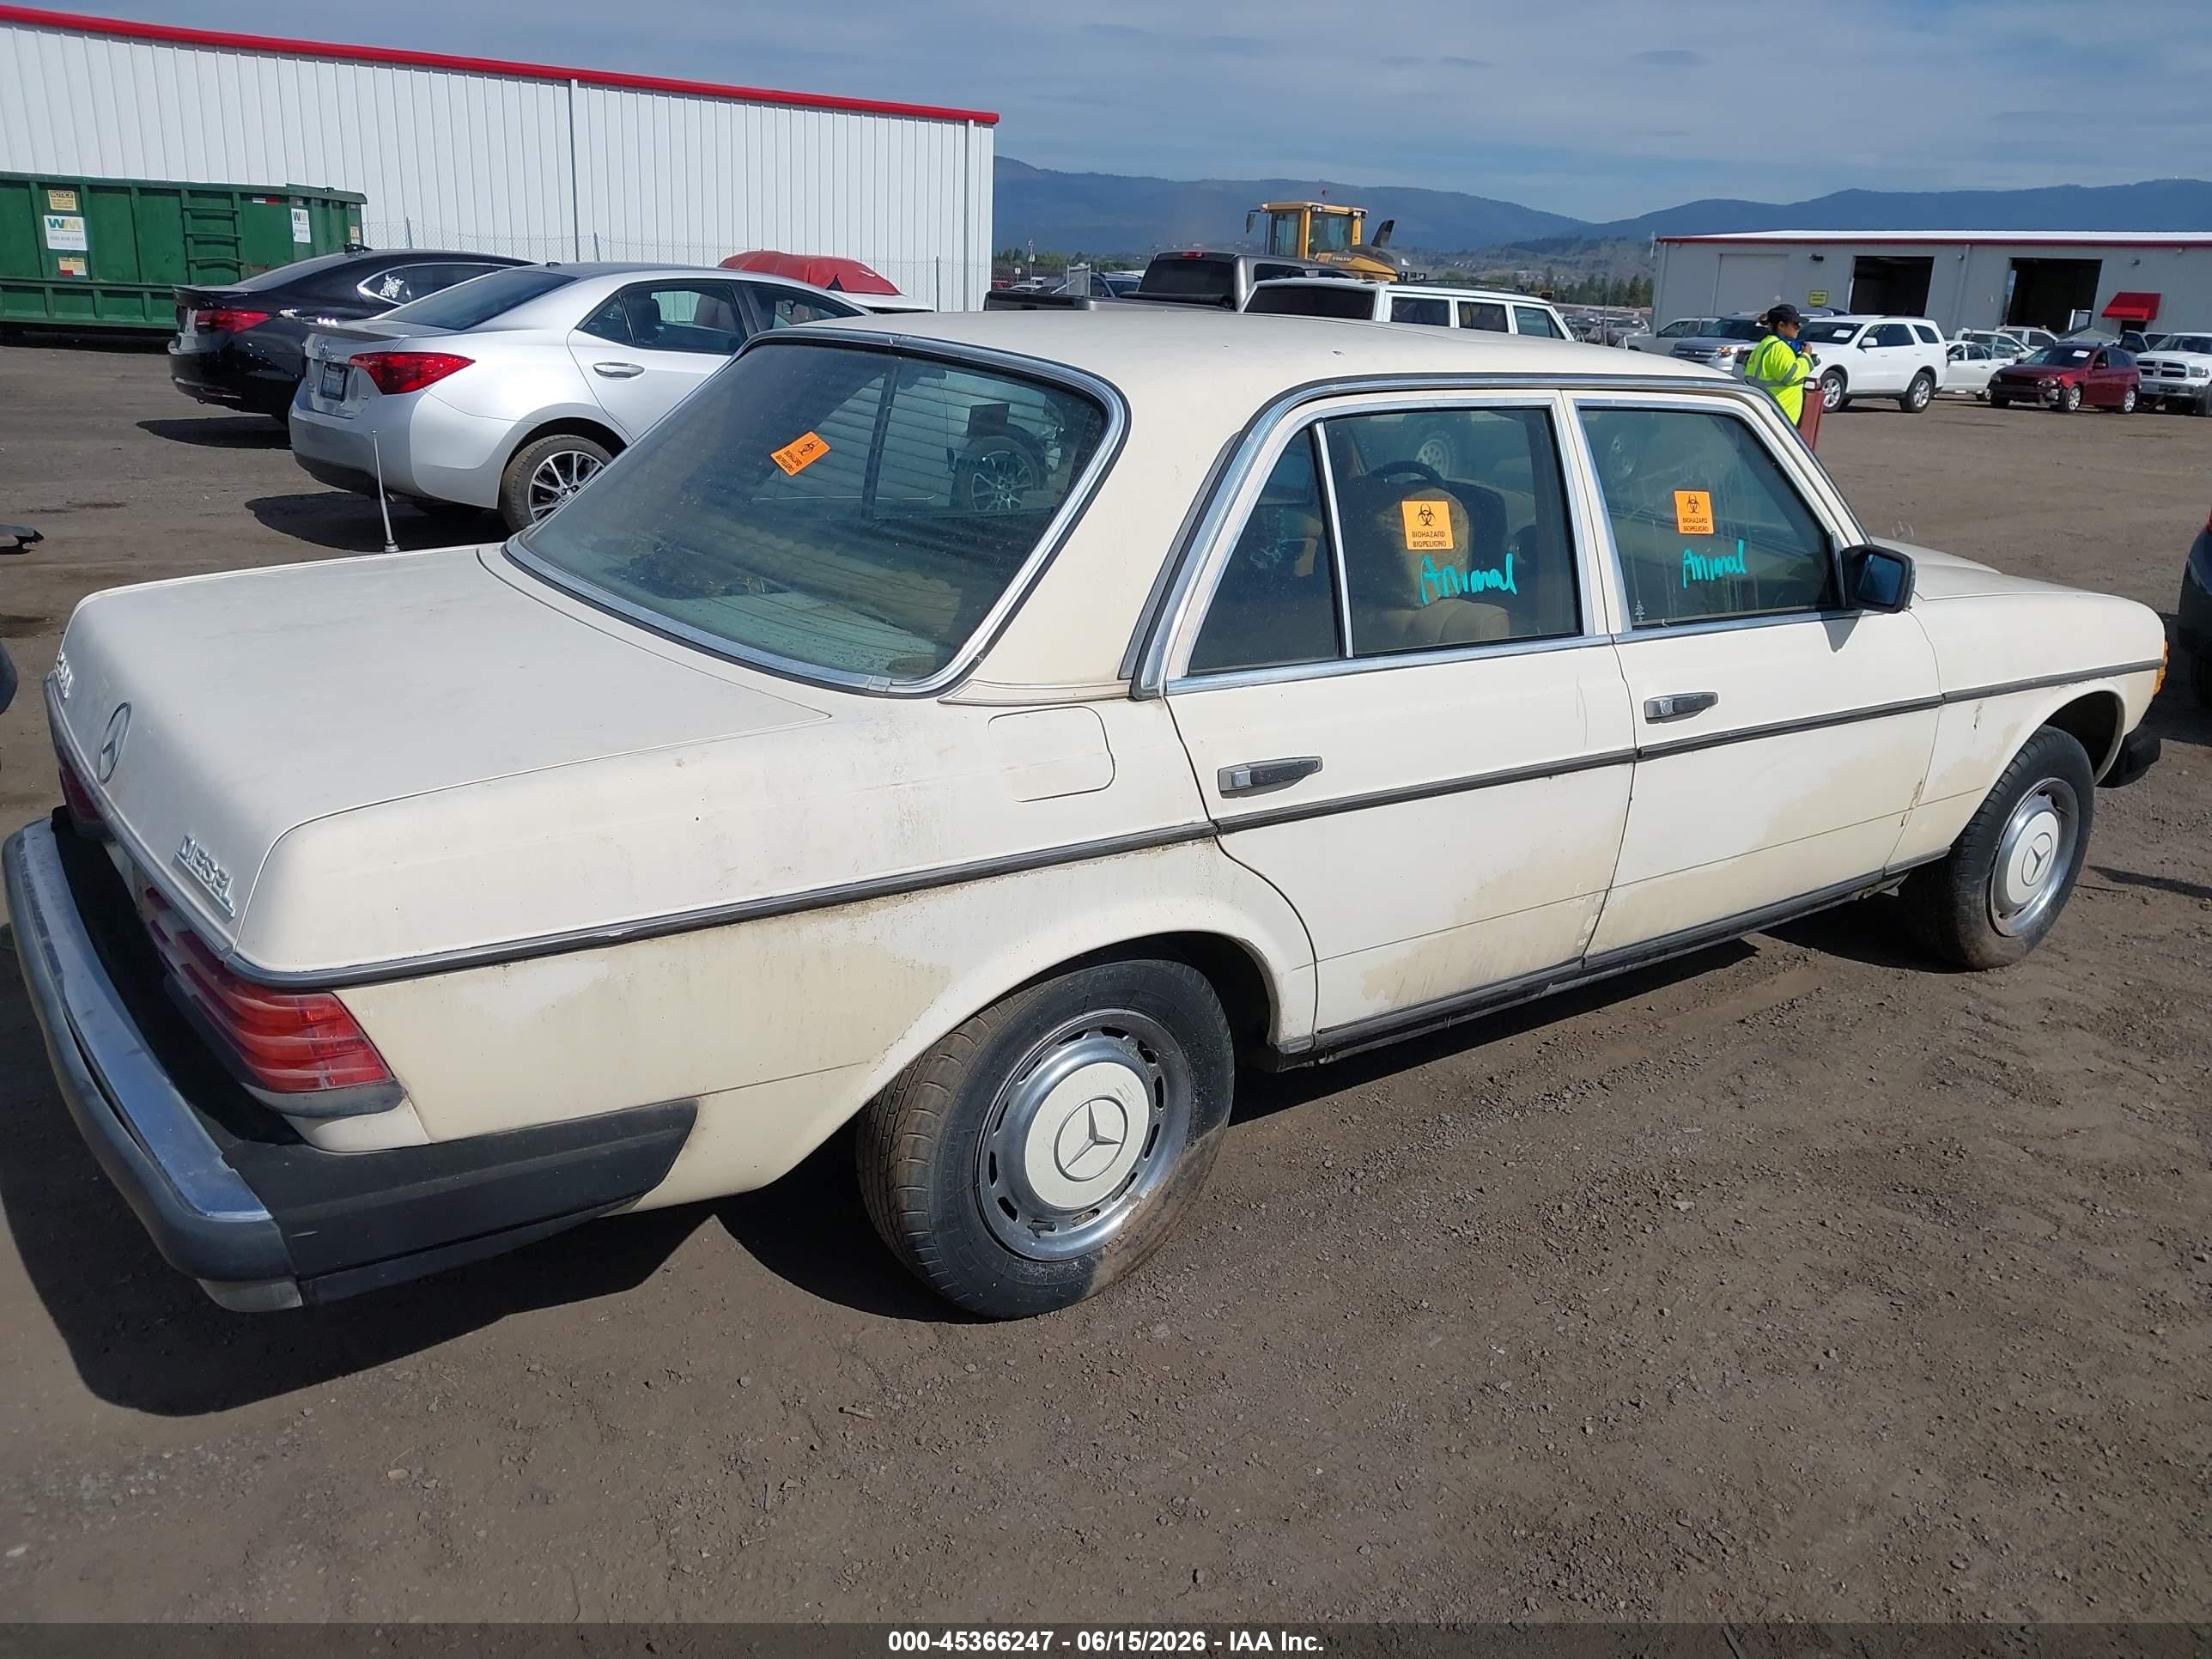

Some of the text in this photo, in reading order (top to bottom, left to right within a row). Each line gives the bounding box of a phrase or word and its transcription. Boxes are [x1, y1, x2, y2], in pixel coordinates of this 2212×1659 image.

[1420, 553, 1517, 605] Animal
[1682, 539, 1747, 589] Animal
[178, 832, 234, 909] DIESEL
